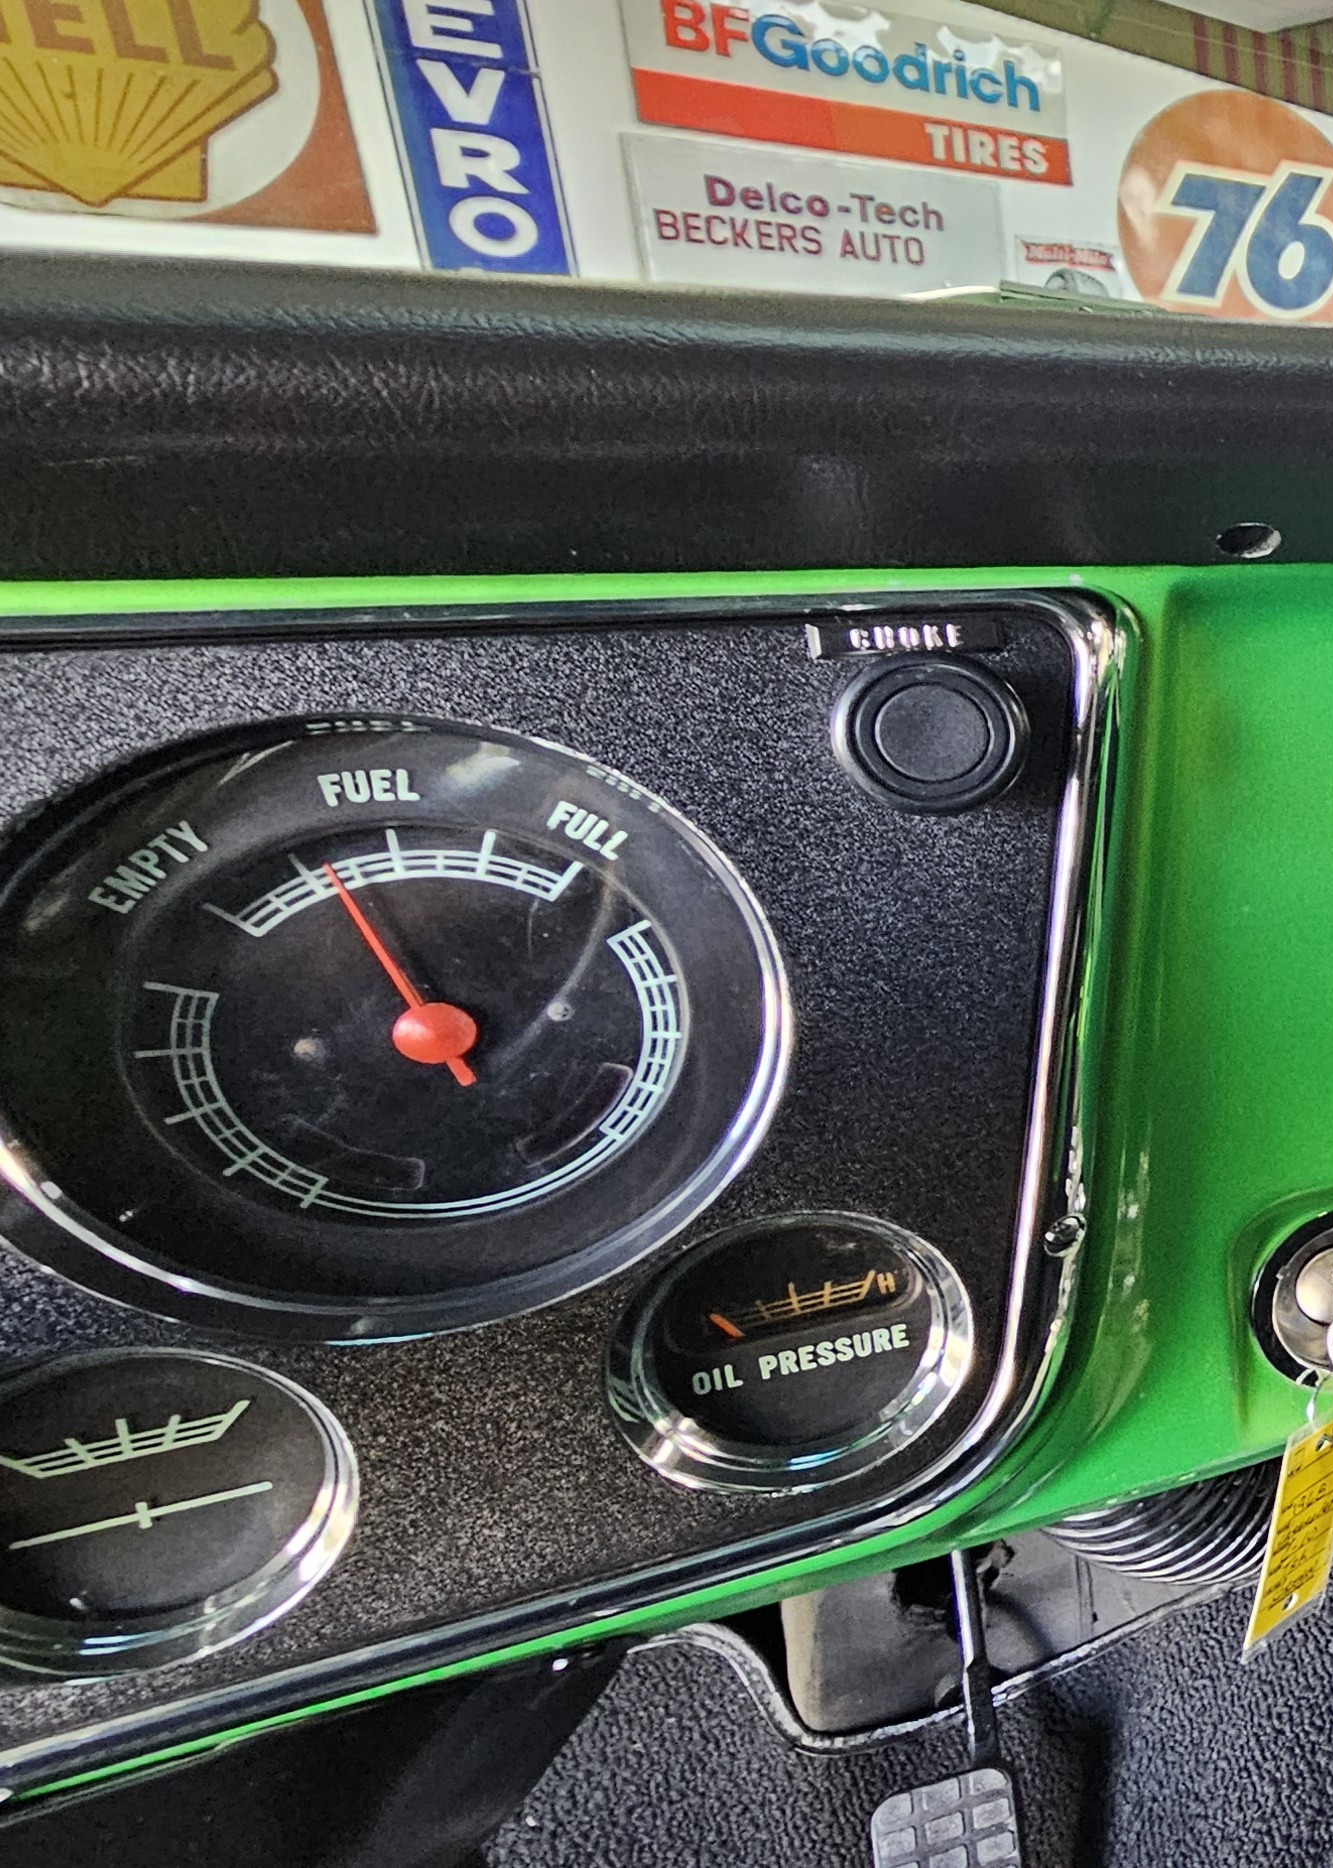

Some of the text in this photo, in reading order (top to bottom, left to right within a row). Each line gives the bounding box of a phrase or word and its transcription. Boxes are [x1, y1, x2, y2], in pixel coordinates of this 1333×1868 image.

[661, 0, 1041, 112] BFGoodrich
[403, 0, 538, 266] EVRO
[924, 122, 1049, 176] TIRES
[653, 208, 926, 267] BECKERS AUTO
[316, 768, 421, 808] FUEL
[545, 799, 633, 862] FULL
[88, 818, 211, 915] EMPTY
[876, 1270, 897, 1295] H
[691, 1323, 911, 1396] OIL PRESSURE
